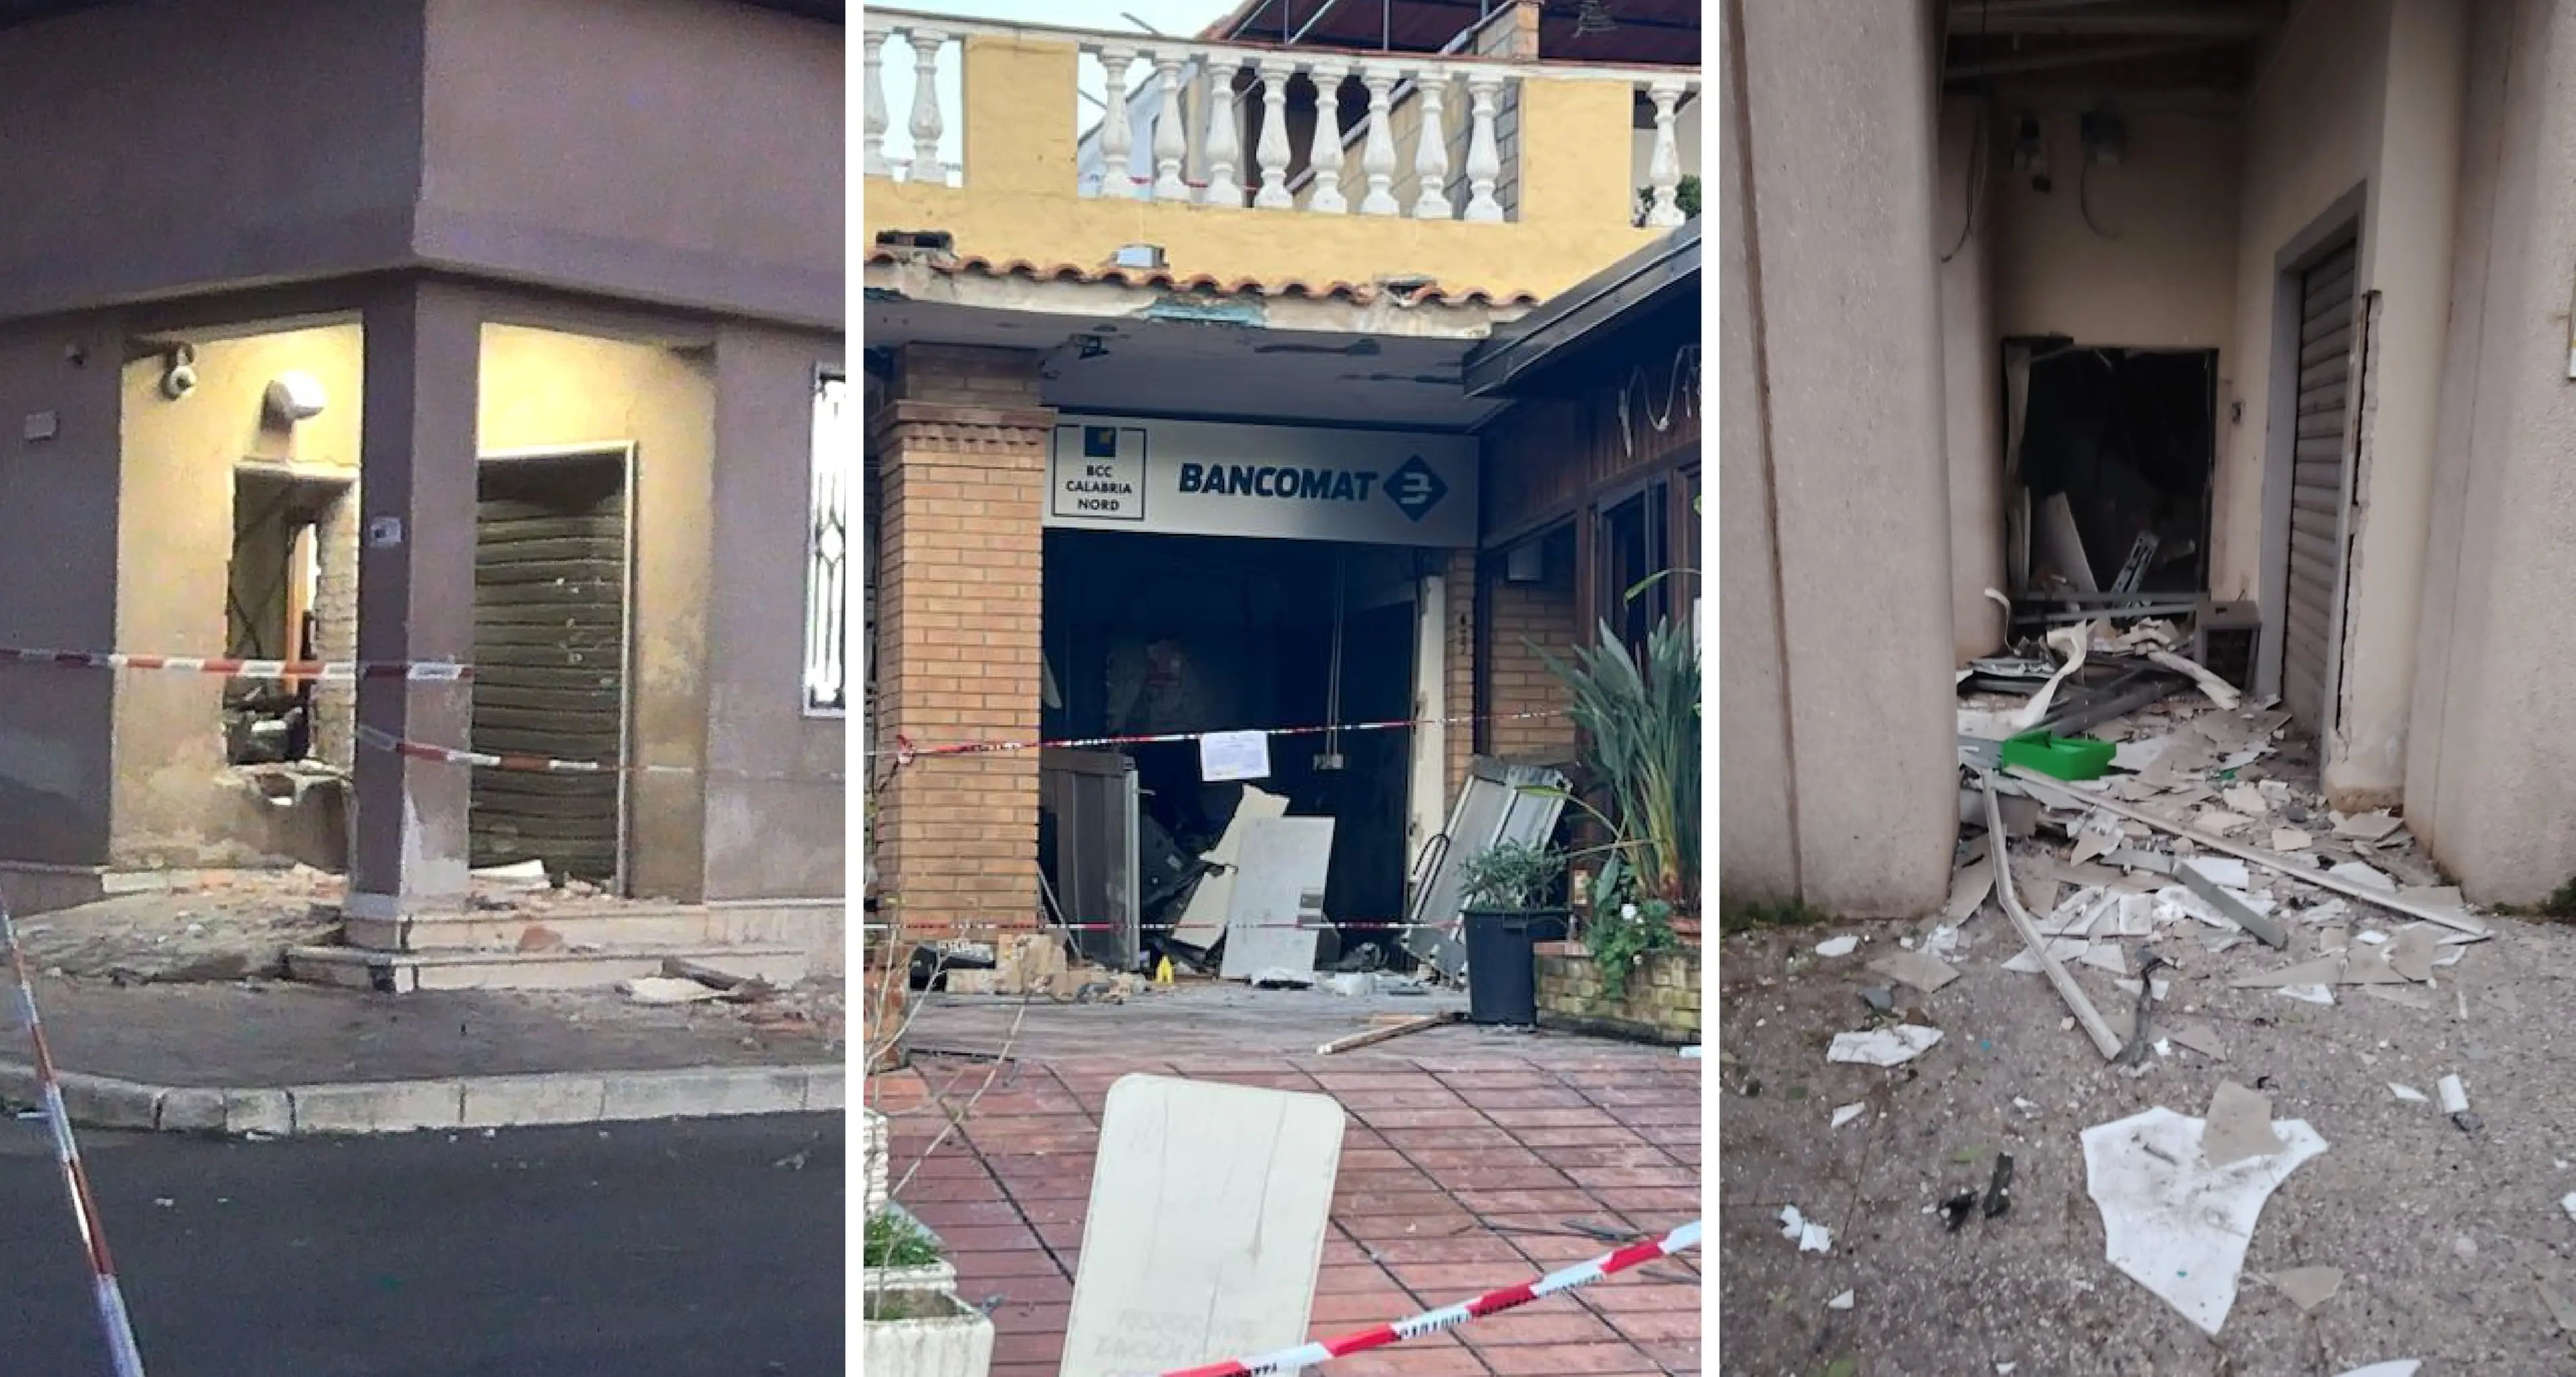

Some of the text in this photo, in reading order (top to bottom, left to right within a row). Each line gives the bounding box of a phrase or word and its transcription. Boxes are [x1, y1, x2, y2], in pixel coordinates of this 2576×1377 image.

[1086, 464, 1112, 478] BCC
[1065, 480, 1132, 494] CALABRIA
[1179, 461, 1379, 502] BANCOMAT
[1077, 498, 1120, 511] NORD
